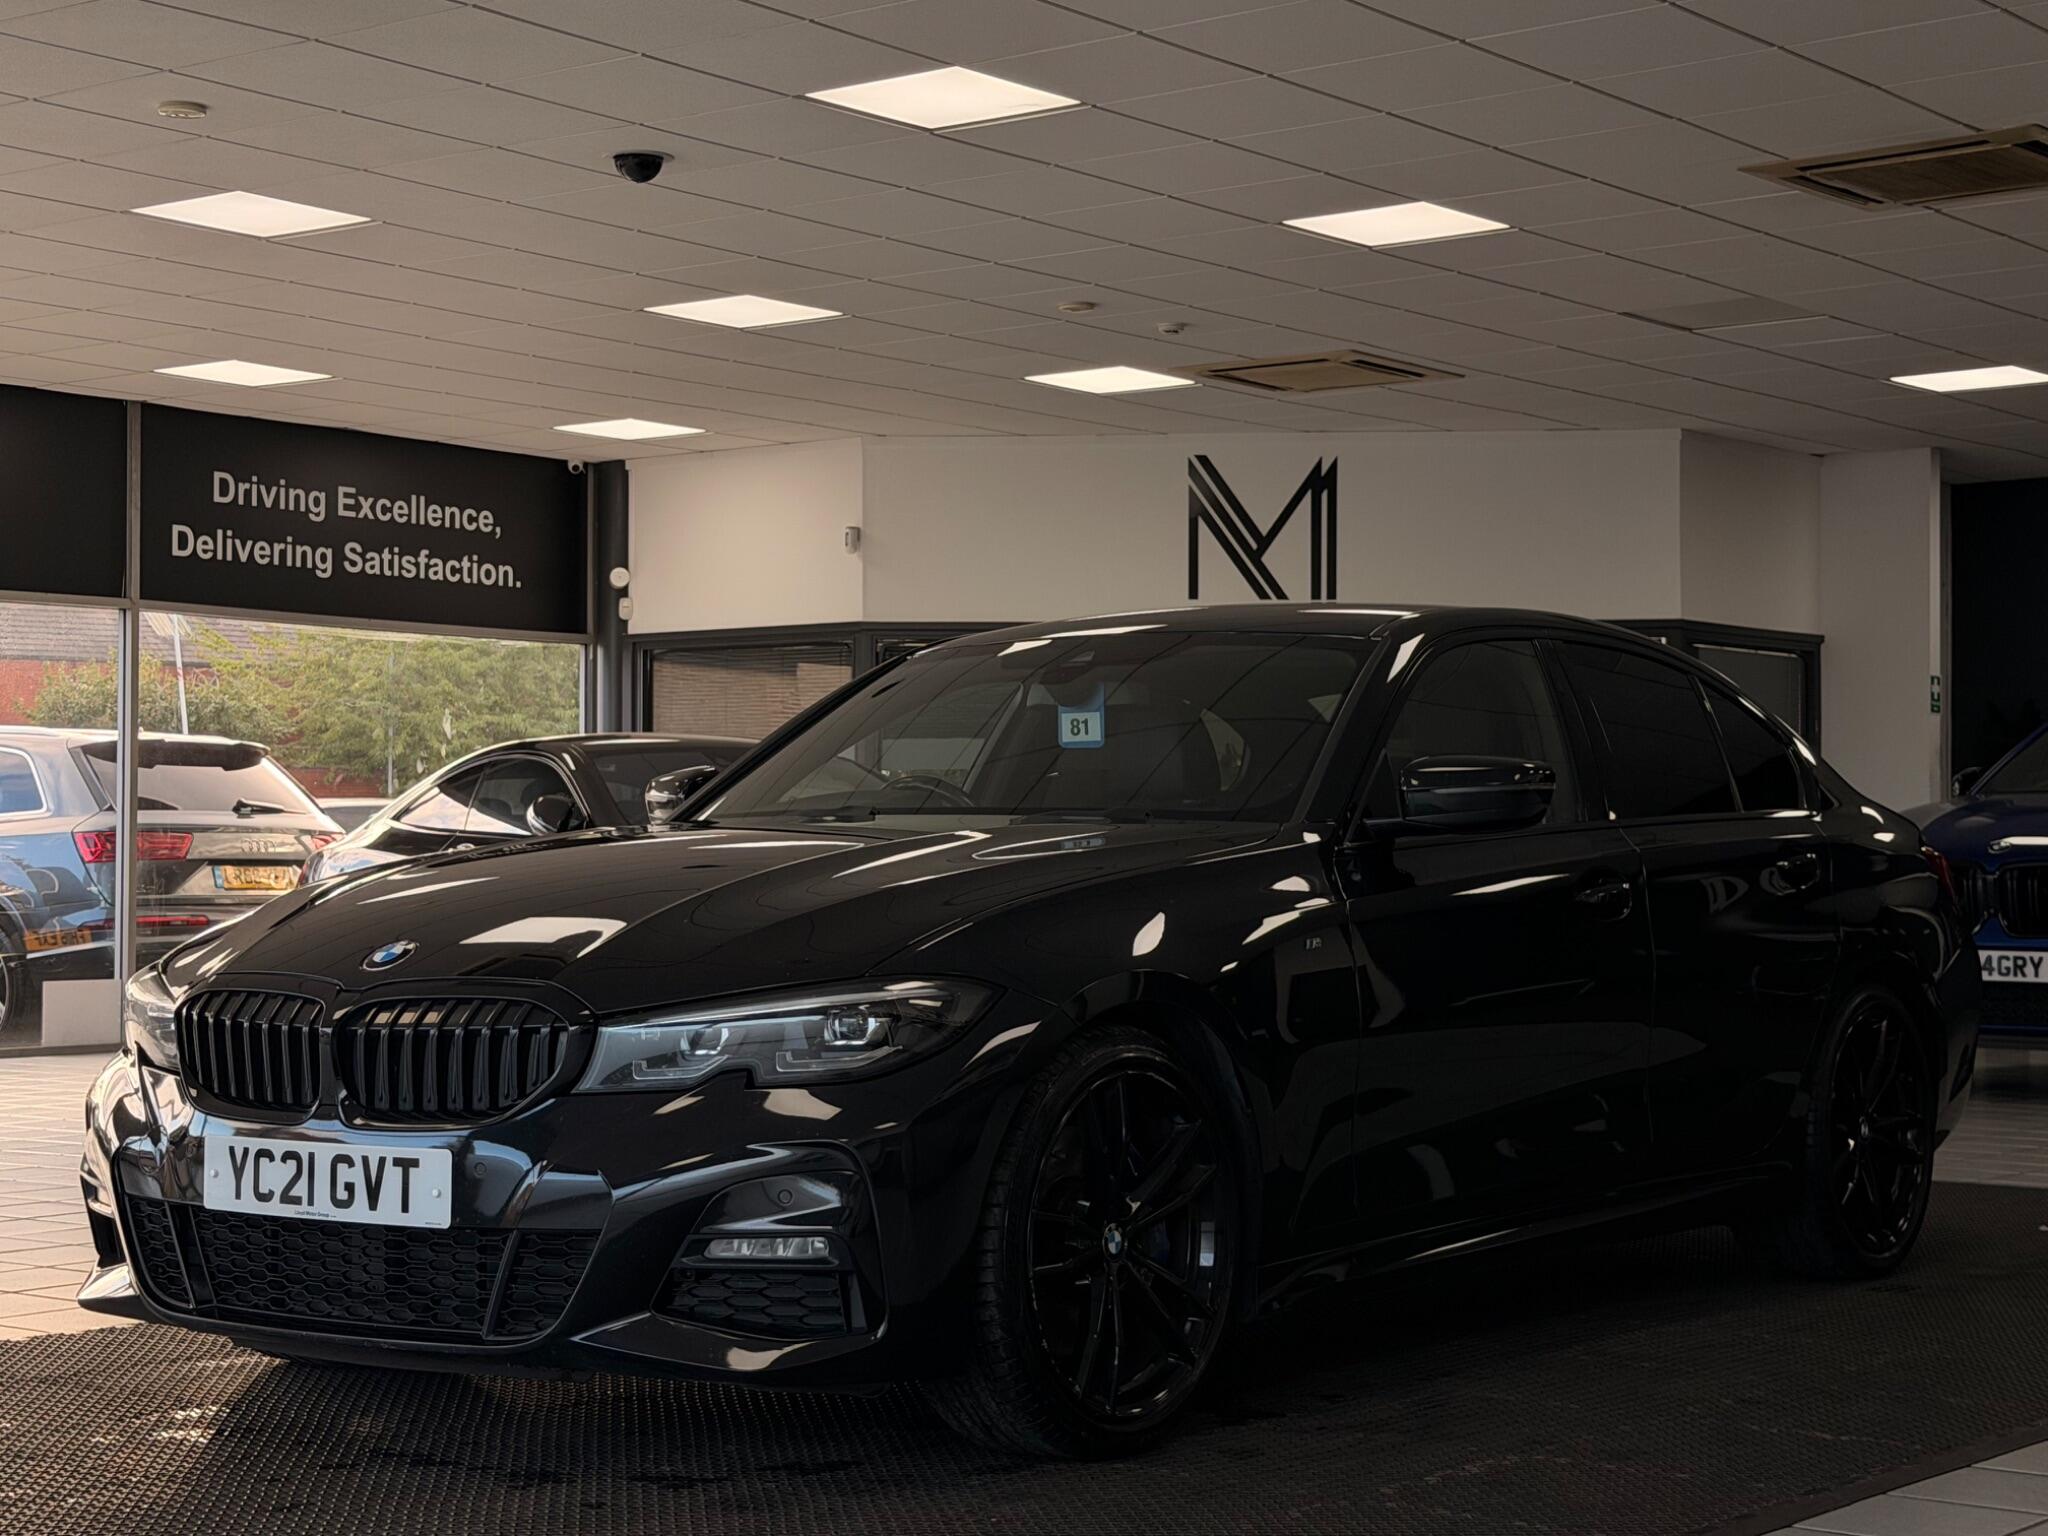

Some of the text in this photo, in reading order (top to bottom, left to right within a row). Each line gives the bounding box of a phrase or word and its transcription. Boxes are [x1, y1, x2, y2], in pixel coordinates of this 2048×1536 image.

[213, 470, 501, 539] Driving Excellence,
[171, 524, 522, 589] Delivering Satisfaction.
[1070, 718, 1089, 736] 81
[228, 1145, 420, 1213] YC21 GVT
